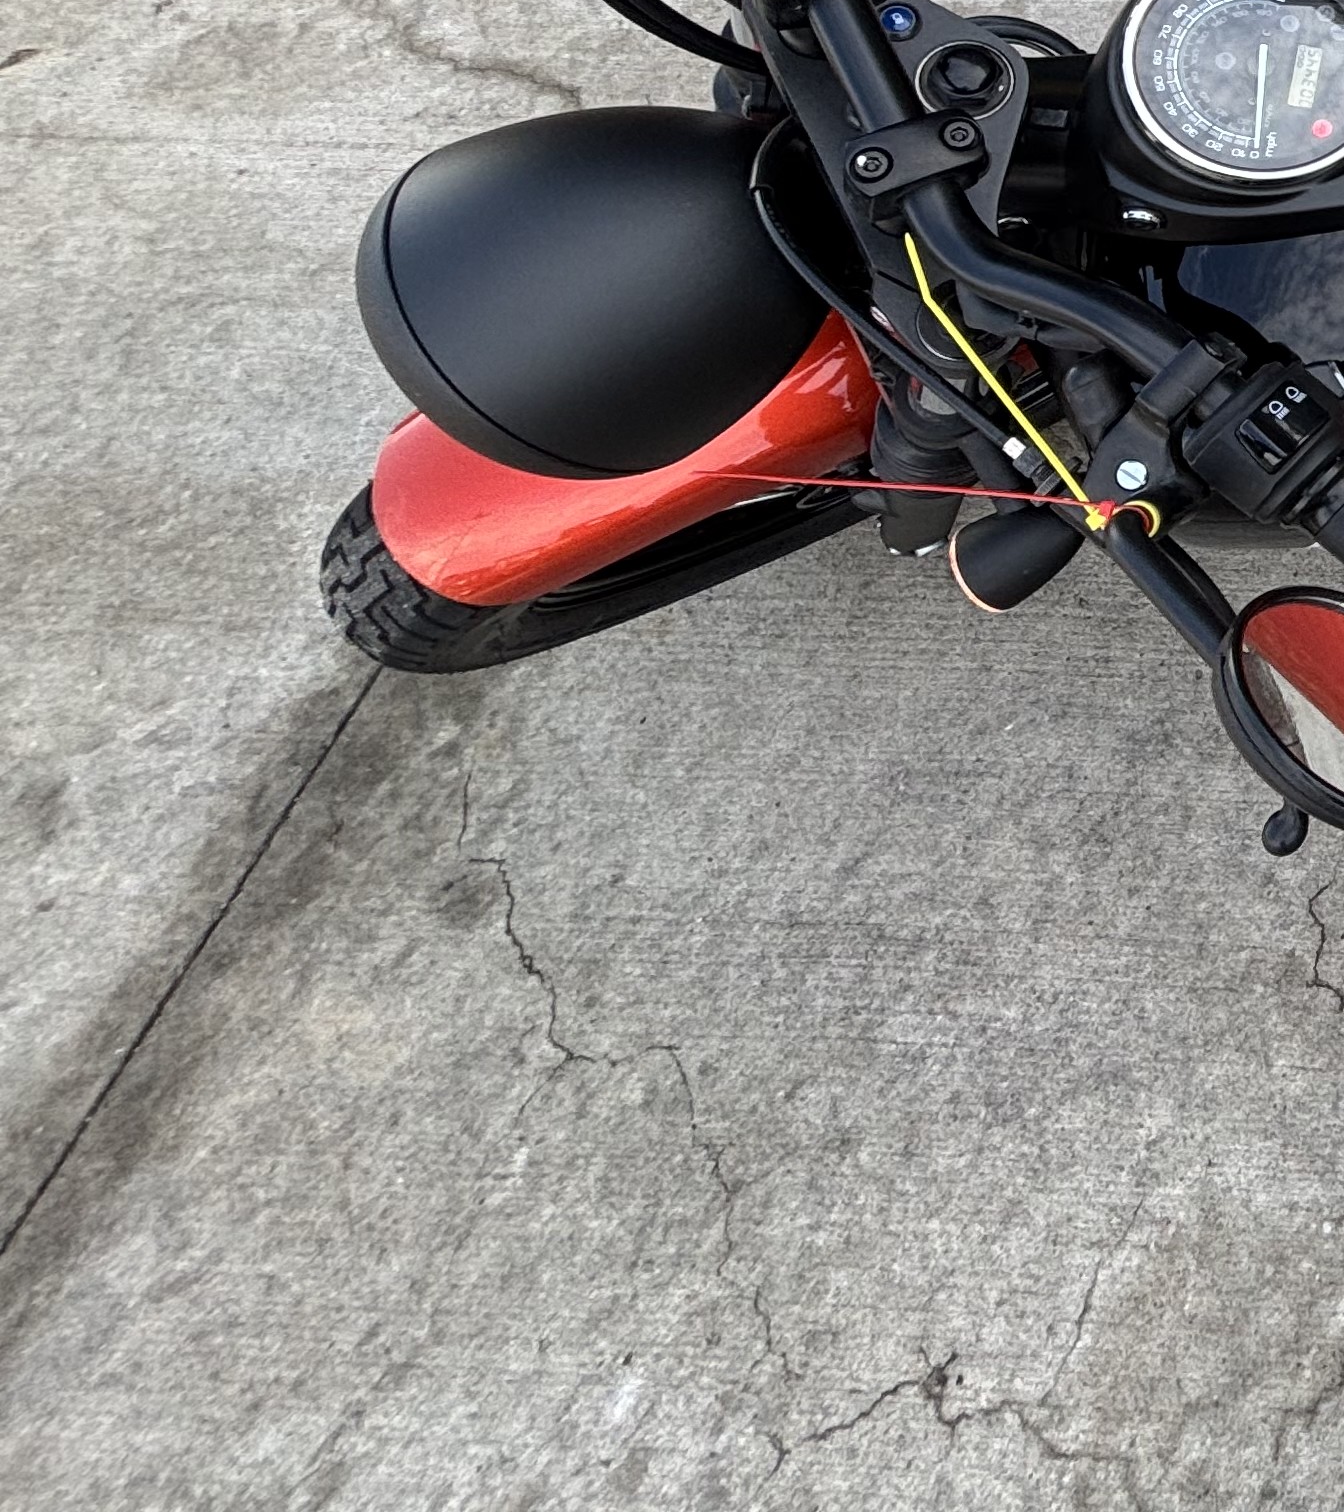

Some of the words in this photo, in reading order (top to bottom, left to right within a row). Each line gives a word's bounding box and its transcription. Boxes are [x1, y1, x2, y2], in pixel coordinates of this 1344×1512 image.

[1173, 4, 1188, 18] 80
[1158, 24, 1173, 39] 70
[1152, 49, 1162, 65] 60
[1153, 75, 1165, 92] 50
[1163, 101, 1177, 116] 40
[1181, 123, 1199, 138] 30
[1205, 139, 1224, 152] 20
[1265, 131, 1277, 157] mph
[1231, 148, 1246, 157] 10
[1250, 150, 1260, 159] 0
